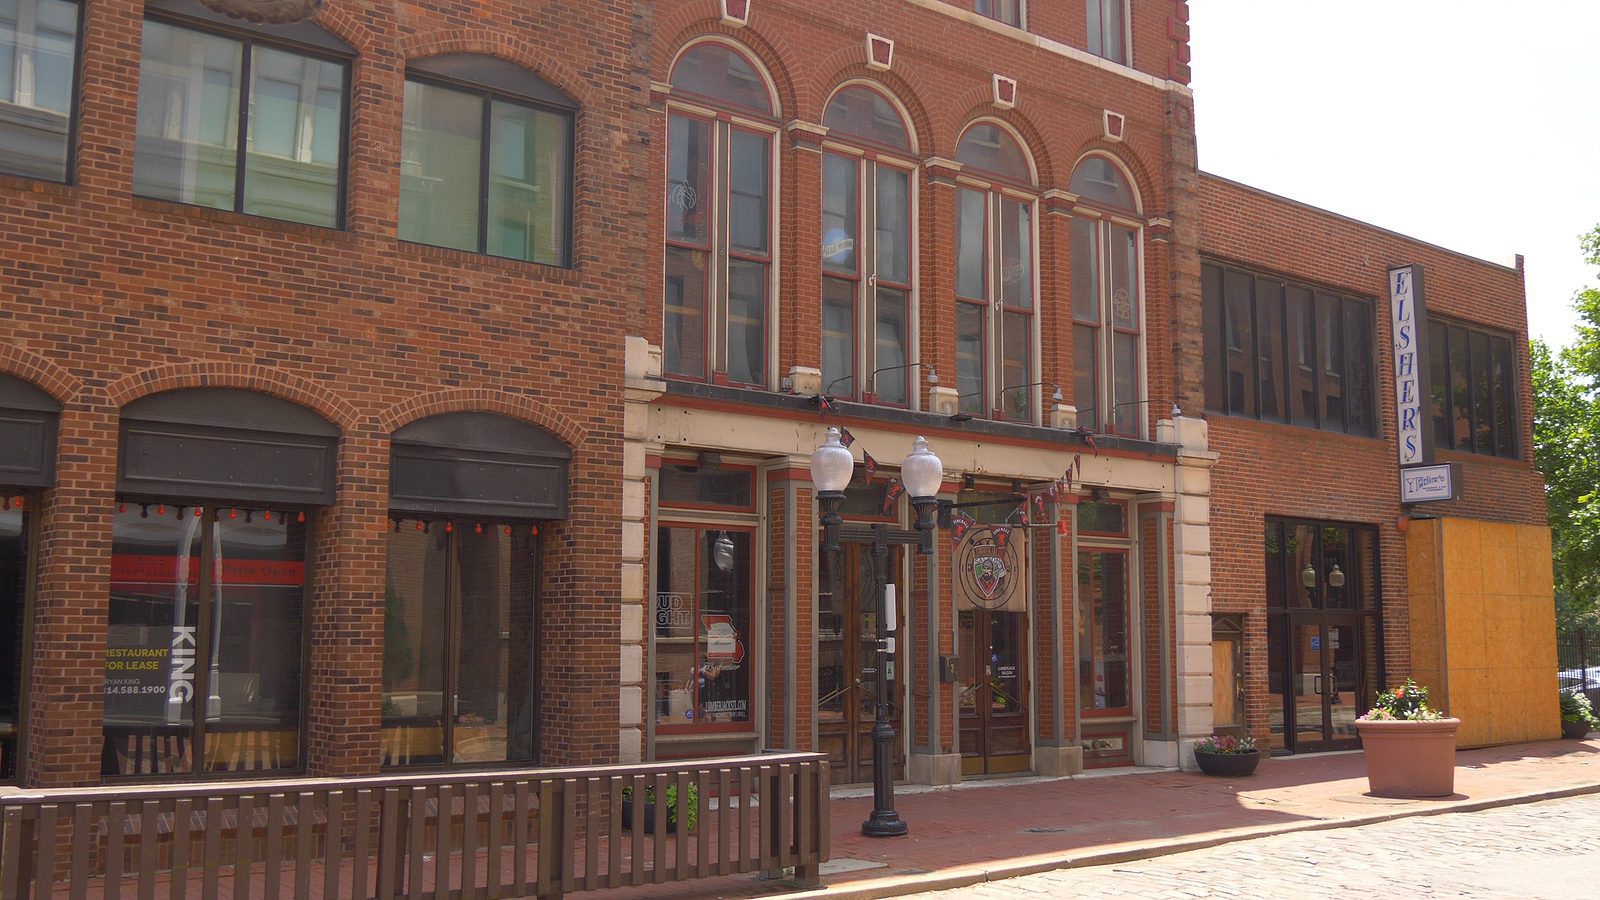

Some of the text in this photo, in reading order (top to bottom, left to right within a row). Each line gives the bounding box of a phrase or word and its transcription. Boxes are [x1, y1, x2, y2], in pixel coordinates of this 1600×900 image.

[656, 595, 683, 610] UD
[656, 610, 690, 625] GHT
[126, 661, 159, 670] LEASE
[170, 626, 196, 704] KING
[104, 685, 166, 694] 14.588.1900
